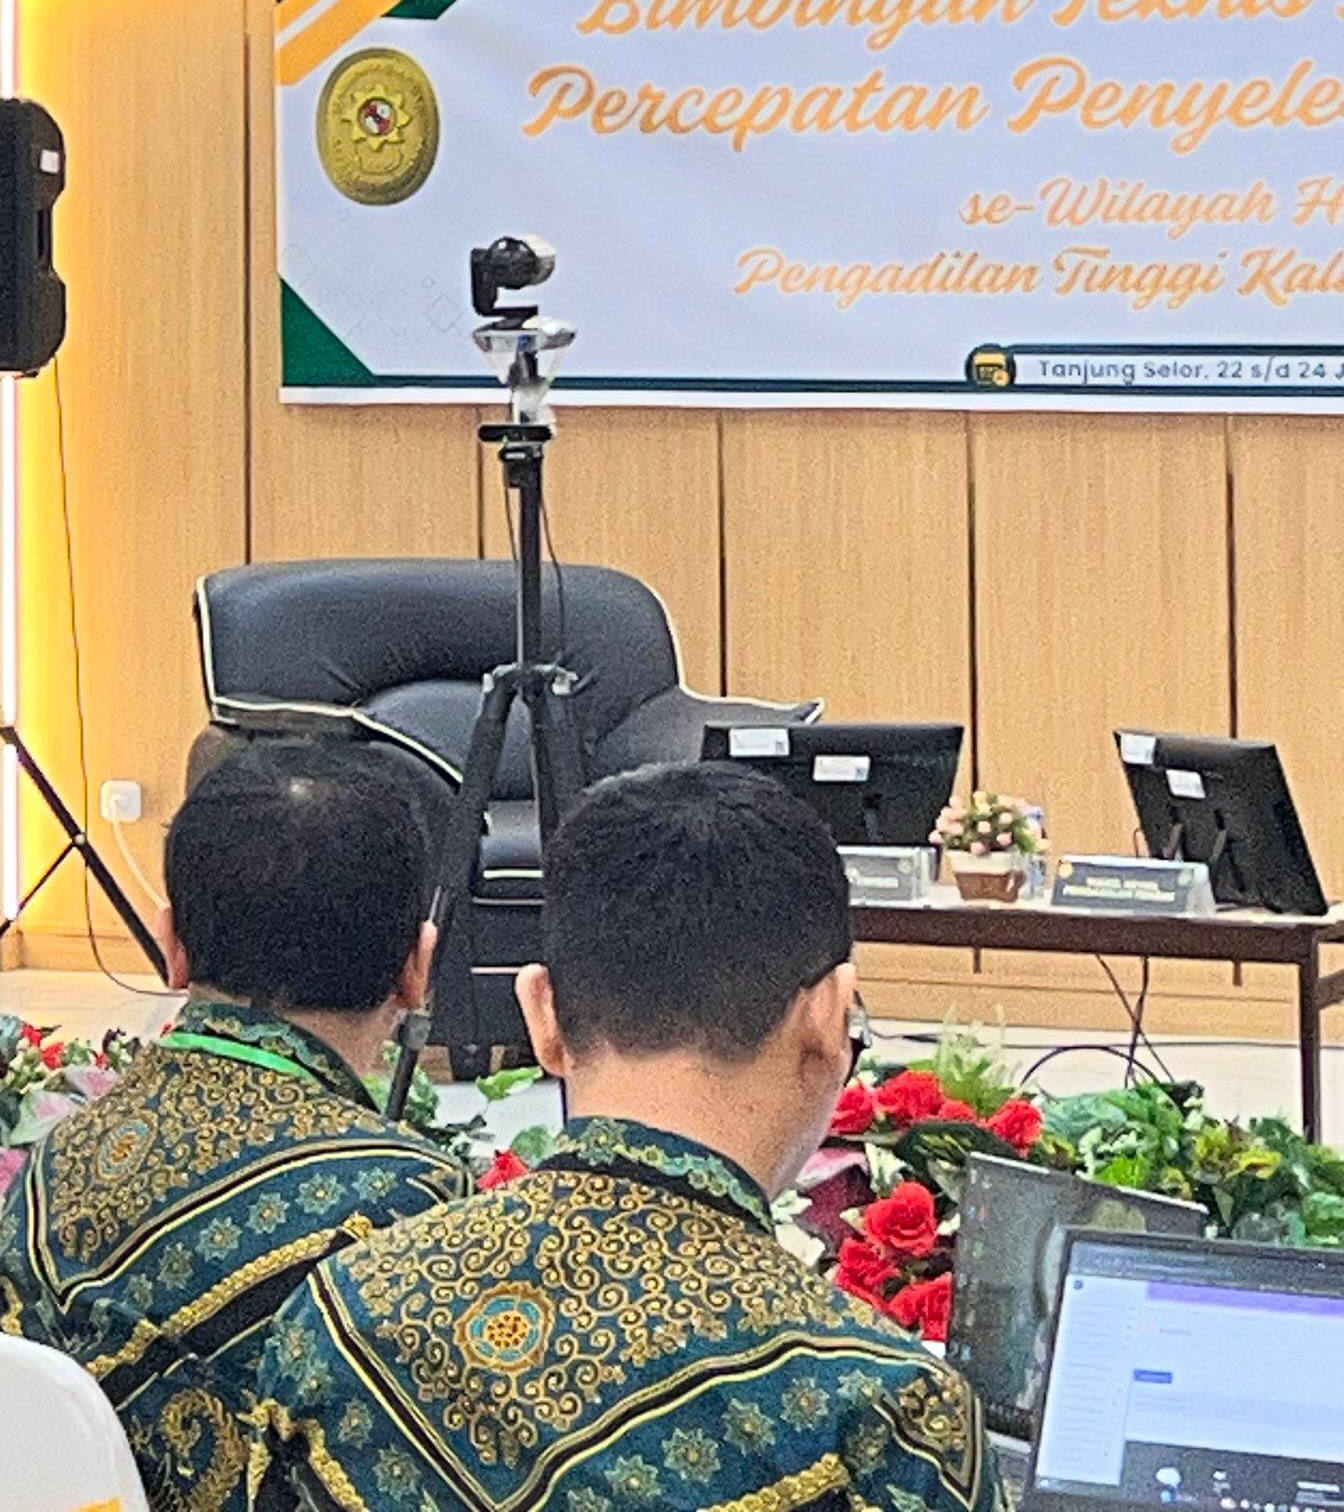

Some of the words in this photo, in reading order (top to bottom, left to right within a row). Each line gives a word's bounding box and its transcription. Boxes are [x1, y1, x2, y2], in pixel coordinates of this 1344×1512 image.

[520, 64, 990, 154] Percepatan
[1006, 55, 1344, 155] Penyele
[958, 176, 1276, 240] se-Wilayah
[733, 246, 1041, 310] Pengadilan
[1052, 244, 1227, 310] Tinggi
[1236, 246, 1344, 308] Kal
[1039, 358, 1135, 384] Tanjung
[1216, 362, 1242, 379] 22
[1250, 356, 1290, 382] s/d
[1298, 362, 1327, 379] 24
